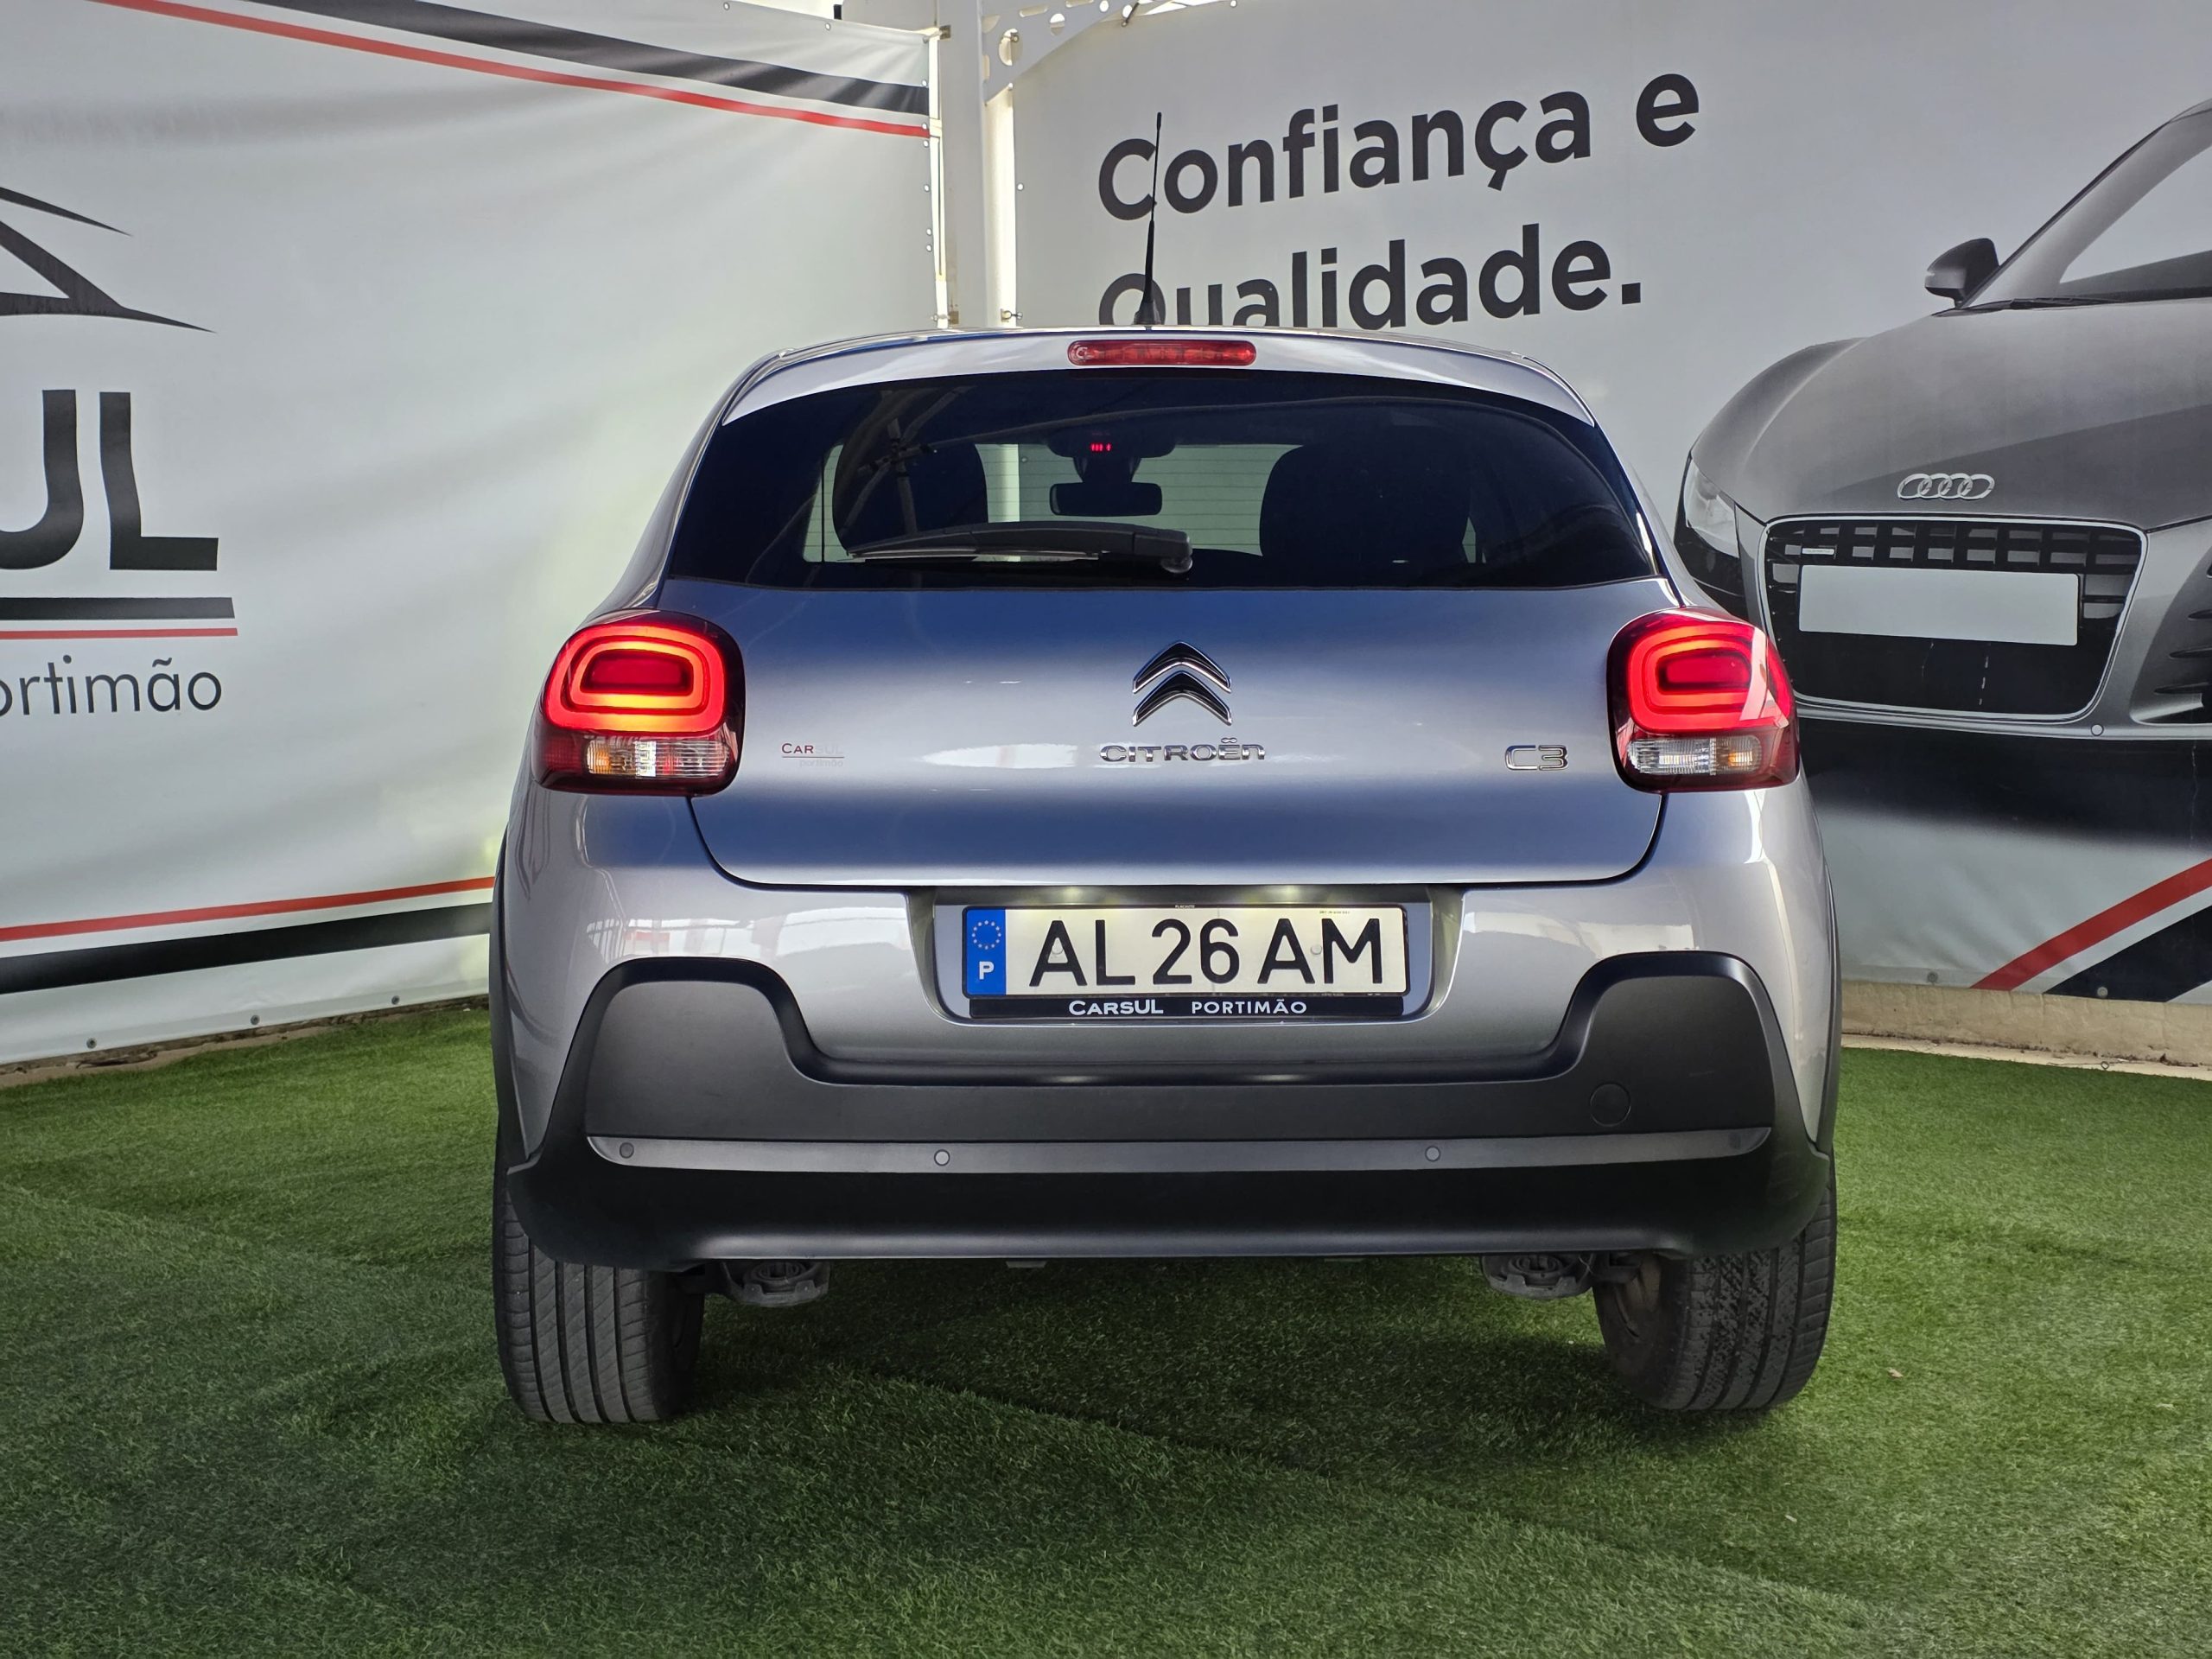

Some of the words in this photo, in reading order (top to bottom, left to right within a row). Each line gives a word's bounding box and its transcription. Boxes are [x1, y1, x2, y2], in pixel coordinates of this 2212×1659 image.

[1098, 90, 1592, 221] Confiança
[1636, 73, 1700, 148] e
[1504, 744, 1569, 771] C3
[1028, 918, 1136, 987] AL
[1151, 918, 1240, 984] 26
[1256, 918, 1383, 985] AM
[978, 961, 995, 981] P
[1068, 999, 1164, 1016] CARSUL
[1191, 999, 1307, 1014] PORTIMÃO
